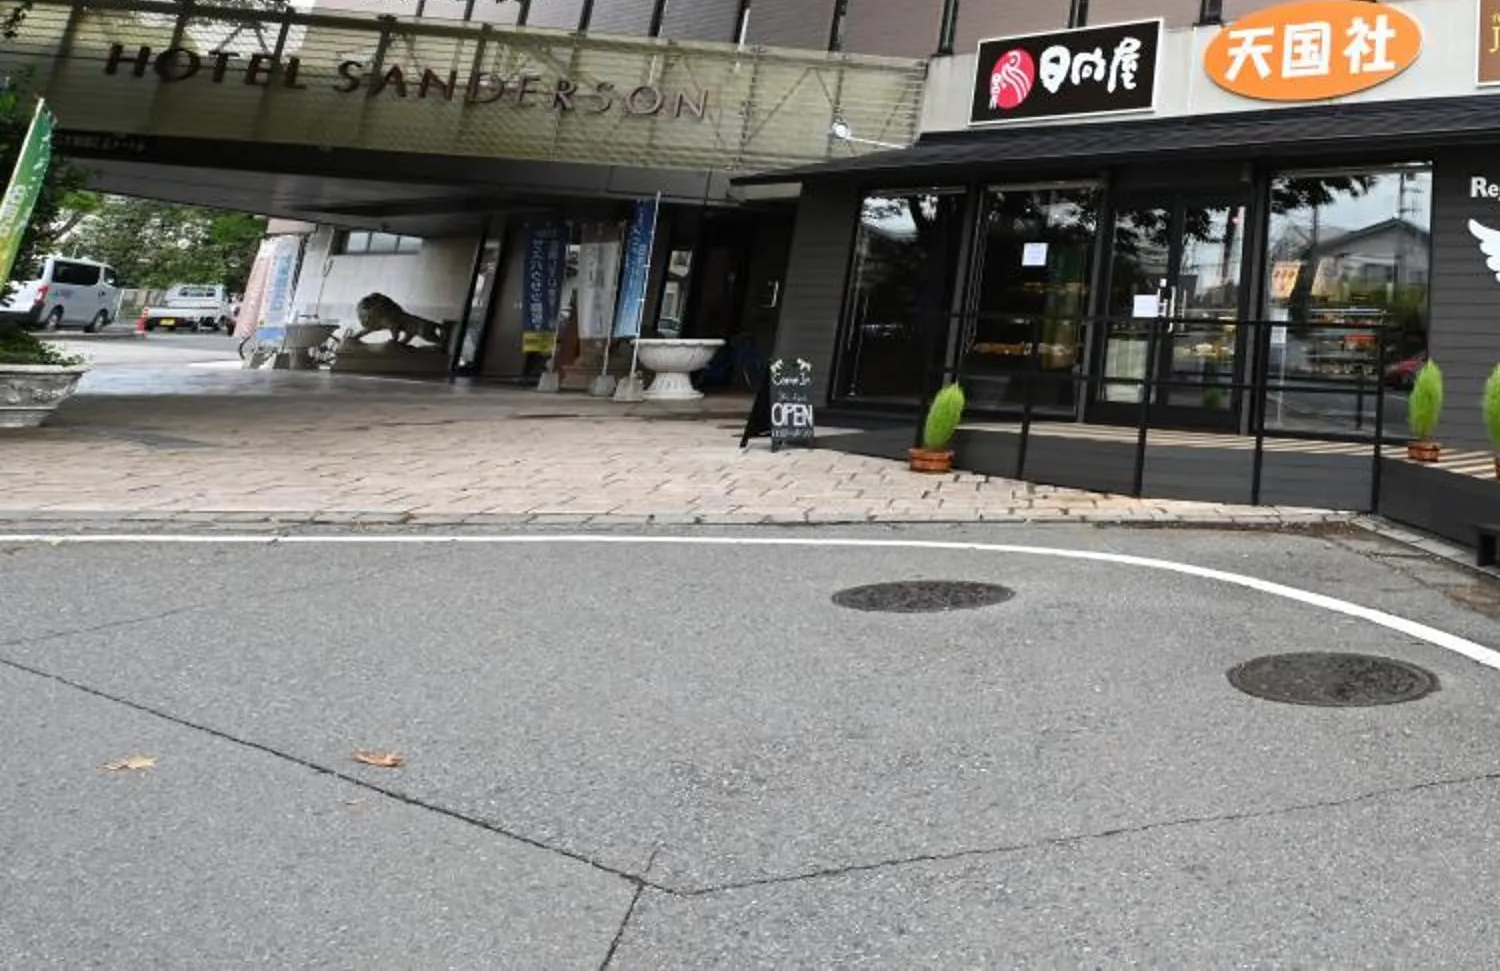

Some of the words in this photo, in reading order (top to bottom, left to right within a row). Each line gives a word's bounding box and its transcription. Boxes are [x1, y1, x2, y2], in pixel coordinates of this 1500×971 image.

[104, 43, 307, 91] HOTEL
[332, 59, 709, 121] SANDERSON
[1224, 13, 1397, 82] 天国社
[771, 402, 813, 426] OPEN
